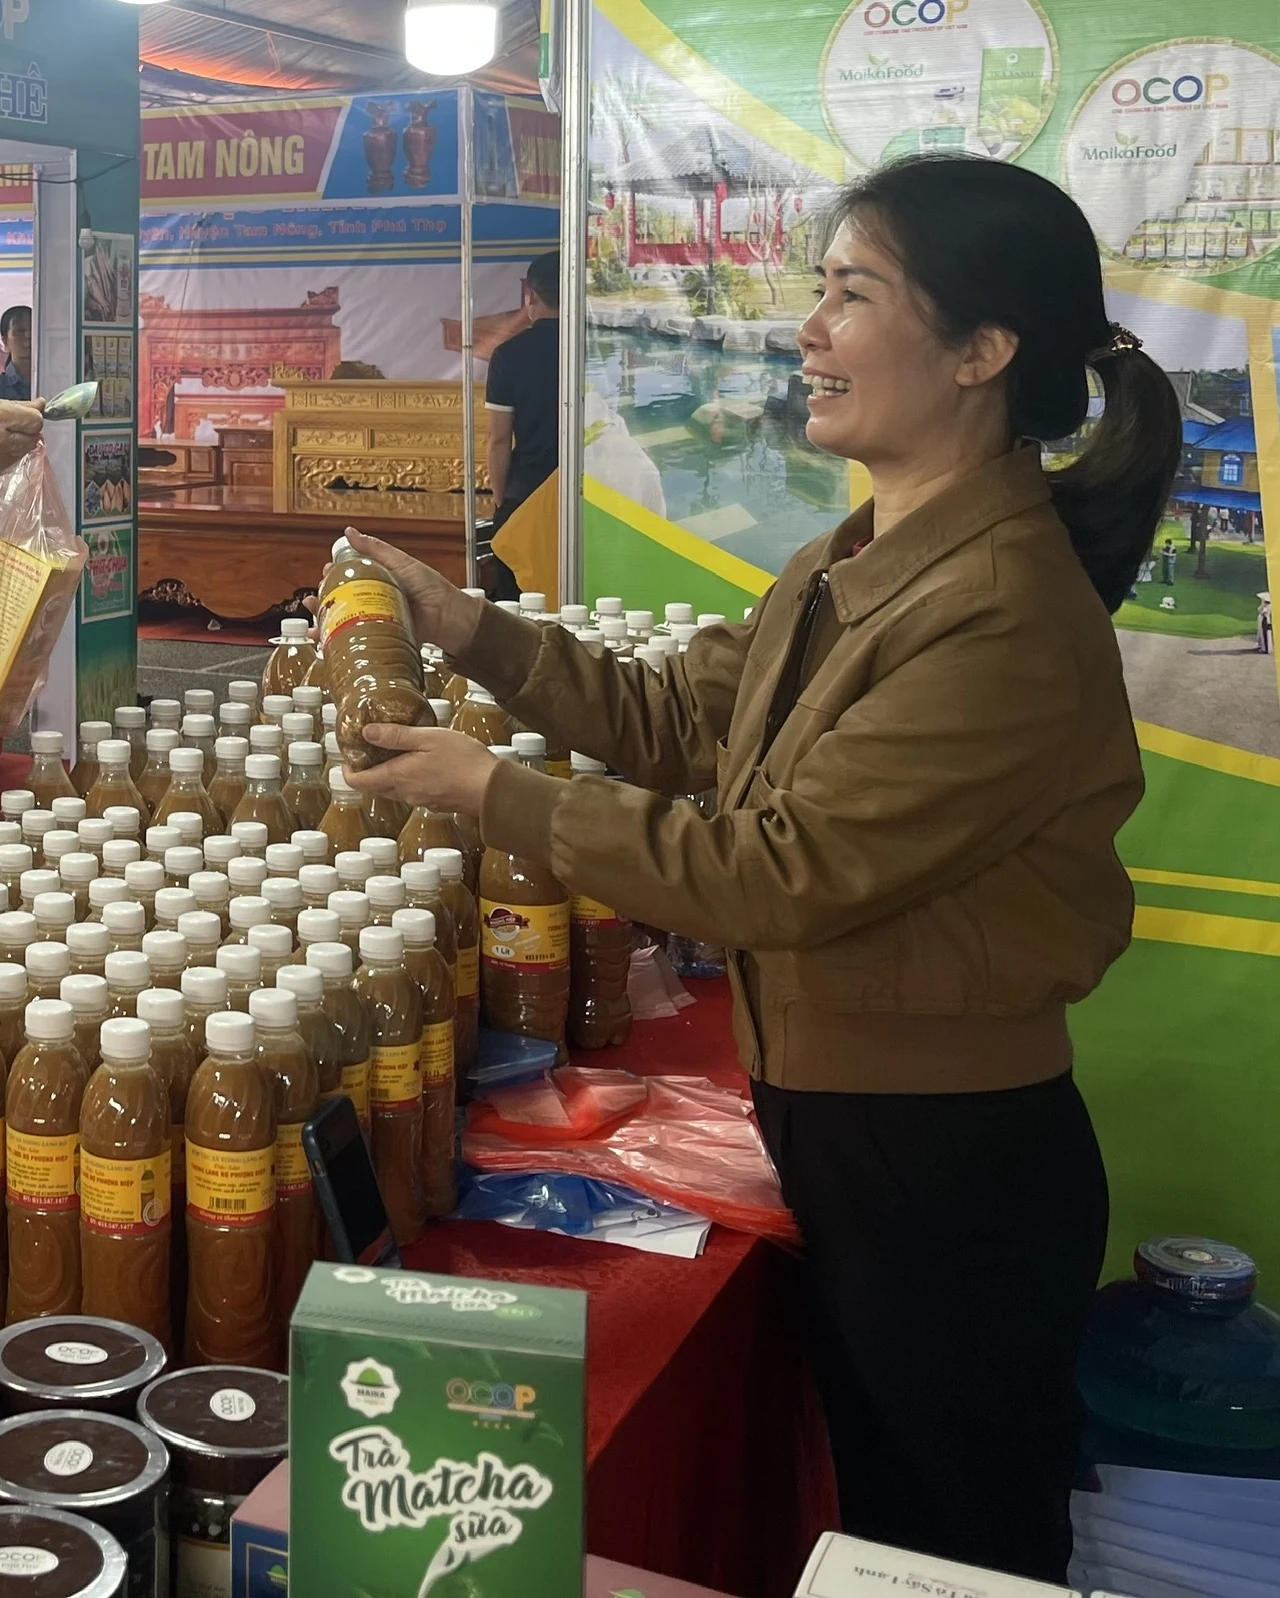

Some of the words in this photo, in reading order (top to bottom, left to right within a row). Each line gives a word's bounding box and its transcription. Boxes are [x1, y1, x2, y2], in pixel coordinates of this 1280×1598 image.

[864, 0, 969, 28] OCOP
[1111, 73, 1230, 107] OCOP
[143, 141, 205, 181] TAM
[215, 131, 305, 179] NÔNG
[447, 1377, 536, 1410] OCOP
[334, 1431, 403, 1474] Trà
[347, 1459, 543, 1525] Matcha
[453, 1508, 515, 1545] sữa
